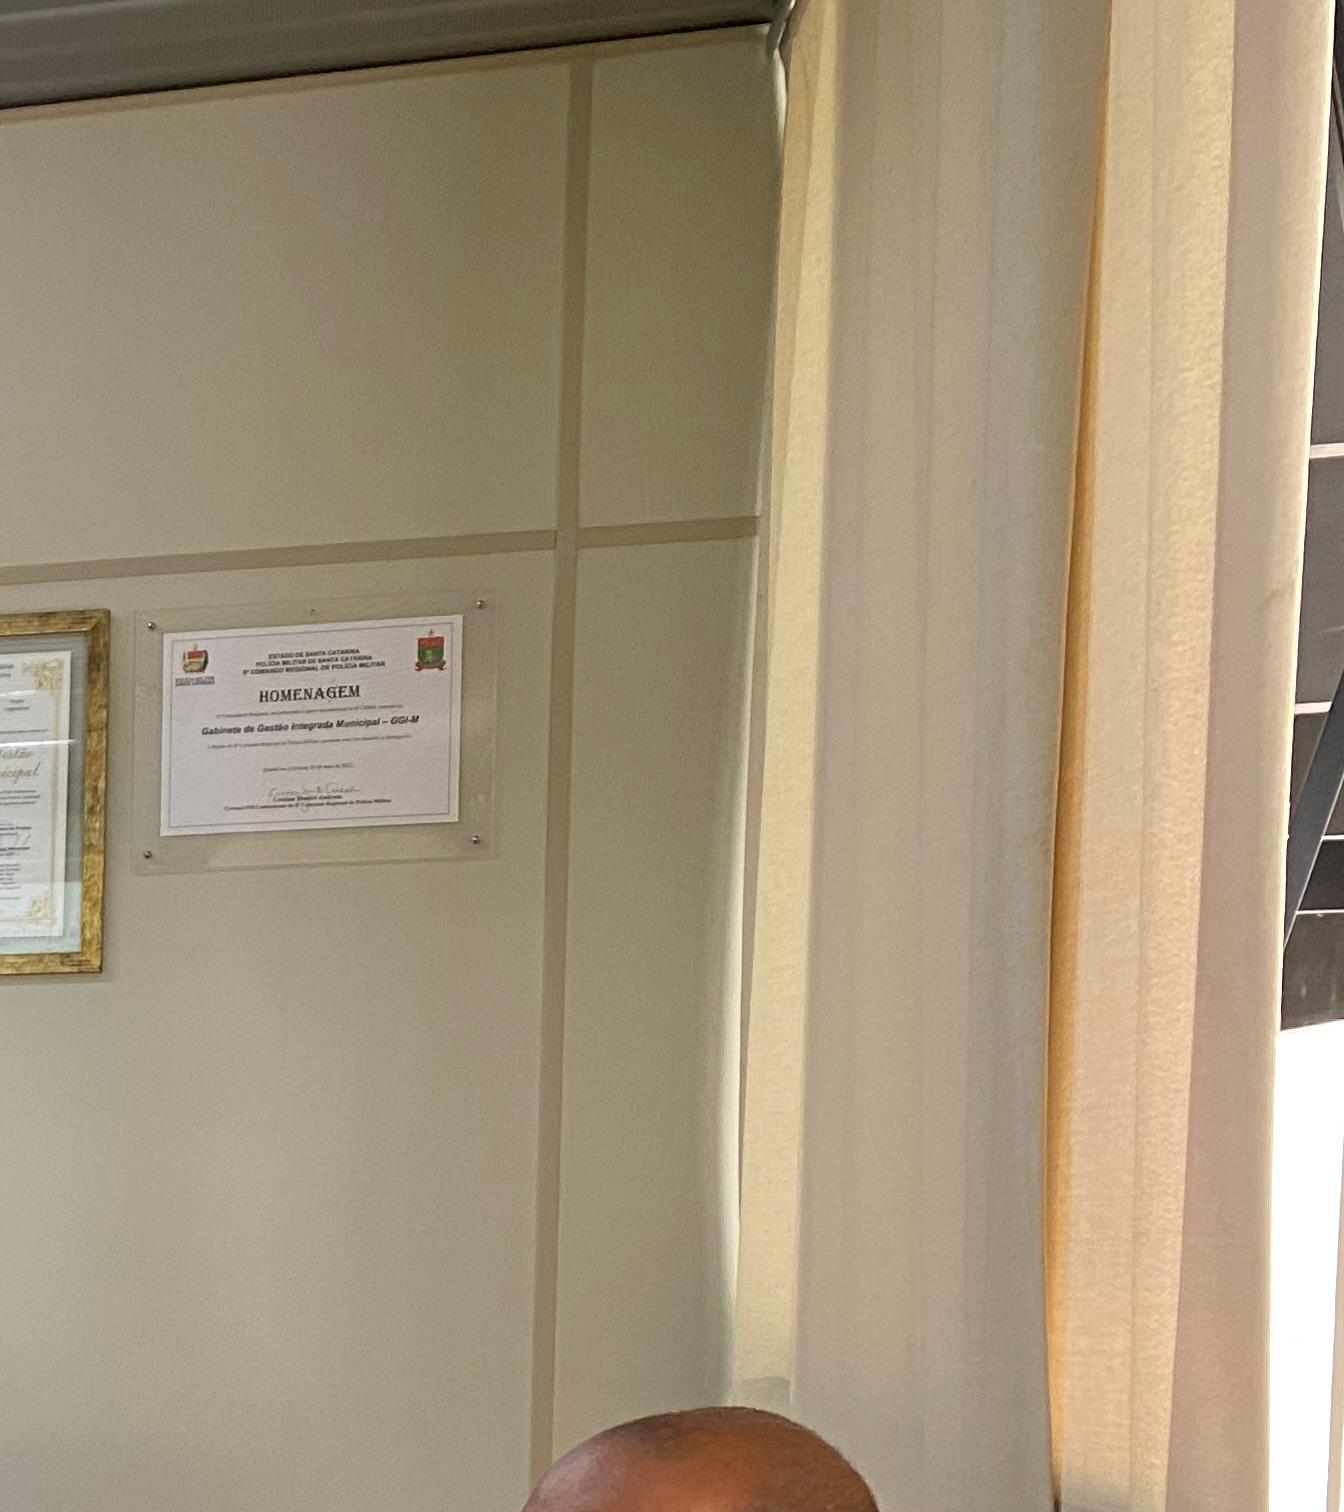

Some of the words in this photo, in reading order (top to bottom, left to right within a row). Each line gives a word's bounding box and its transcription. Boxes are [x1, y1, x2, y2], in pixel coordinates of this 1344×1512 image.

[258, 685, 360, 702] HOMENAGEM
[201, 726, 242, 736] Gabinete
[243, 724, 254, 734] de
[256, 722, 289, 732] Gestão
[290, 720, 334, 732] Integrada
[336, 717, 381, 728] Municipal
